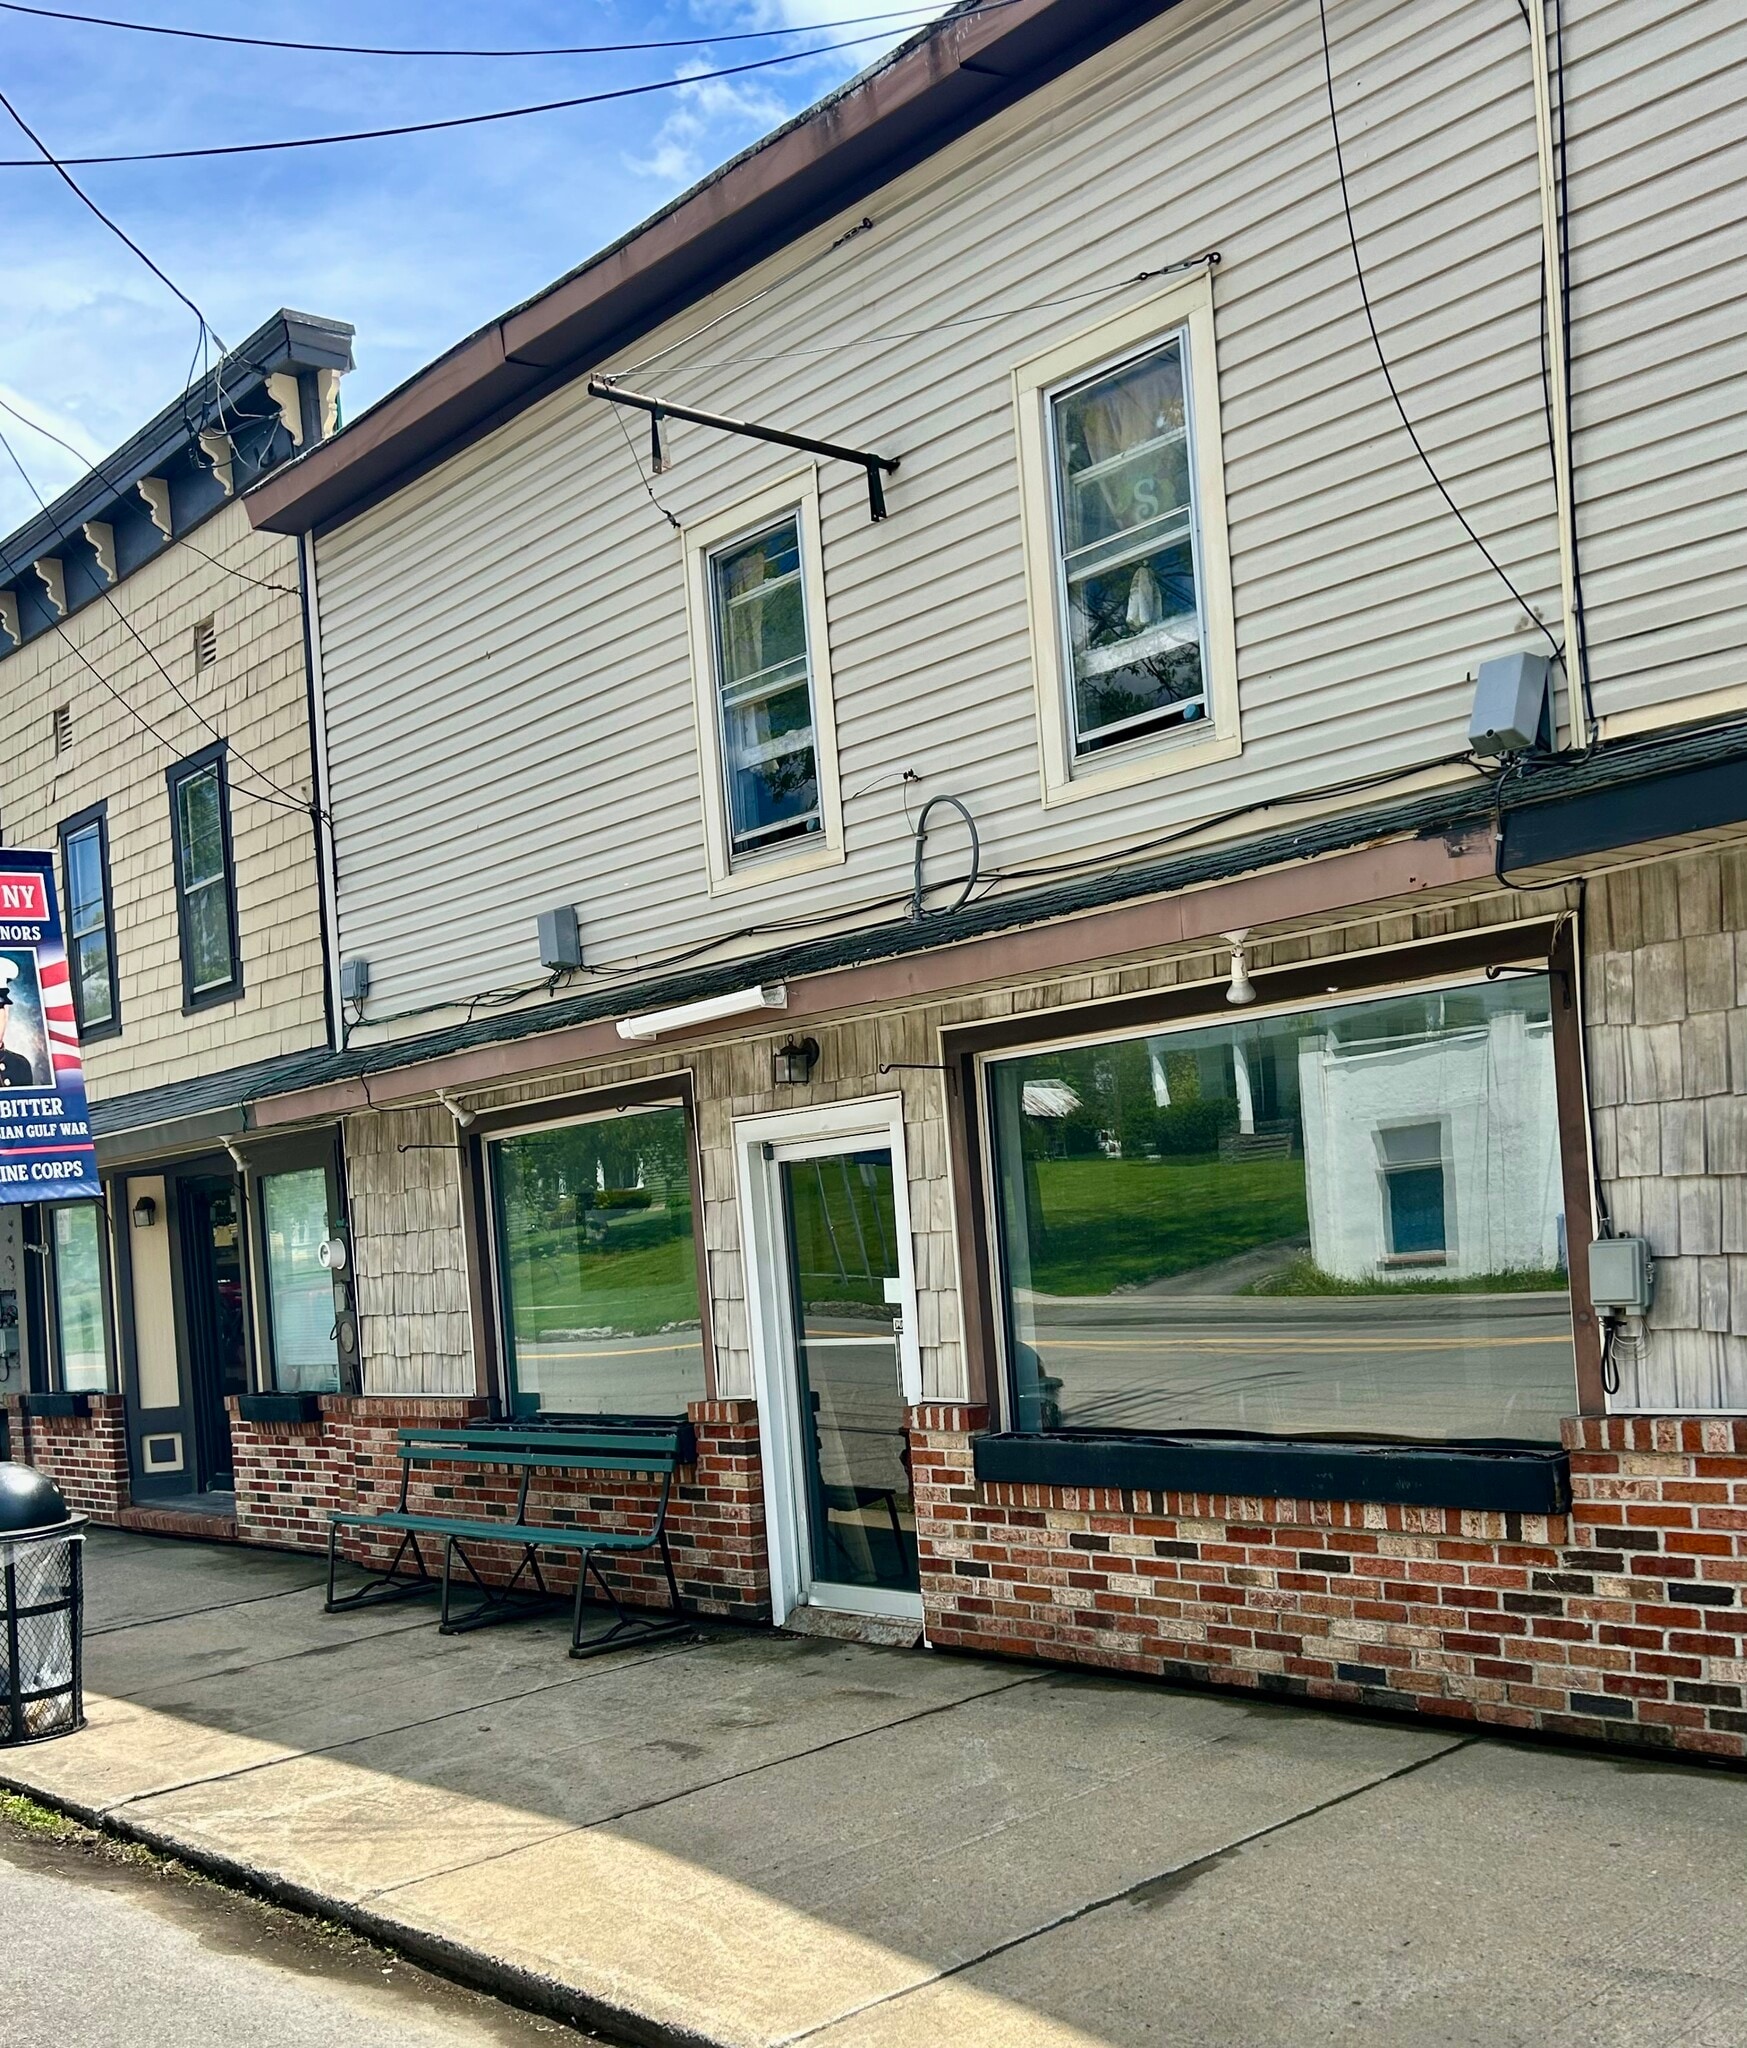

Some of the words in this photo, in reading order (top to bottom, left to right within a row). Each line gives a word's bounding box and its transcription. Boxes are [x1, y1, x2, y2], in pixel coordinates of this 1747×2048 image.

[1, 885, 35, 908] NY
[0, 1097, 64, 1118] BITTER
[26, 1123, 57, 1138] GULF
[60, 1122, 89, 1136] WAR
[31, 1160, 84, 1180] CORPS
